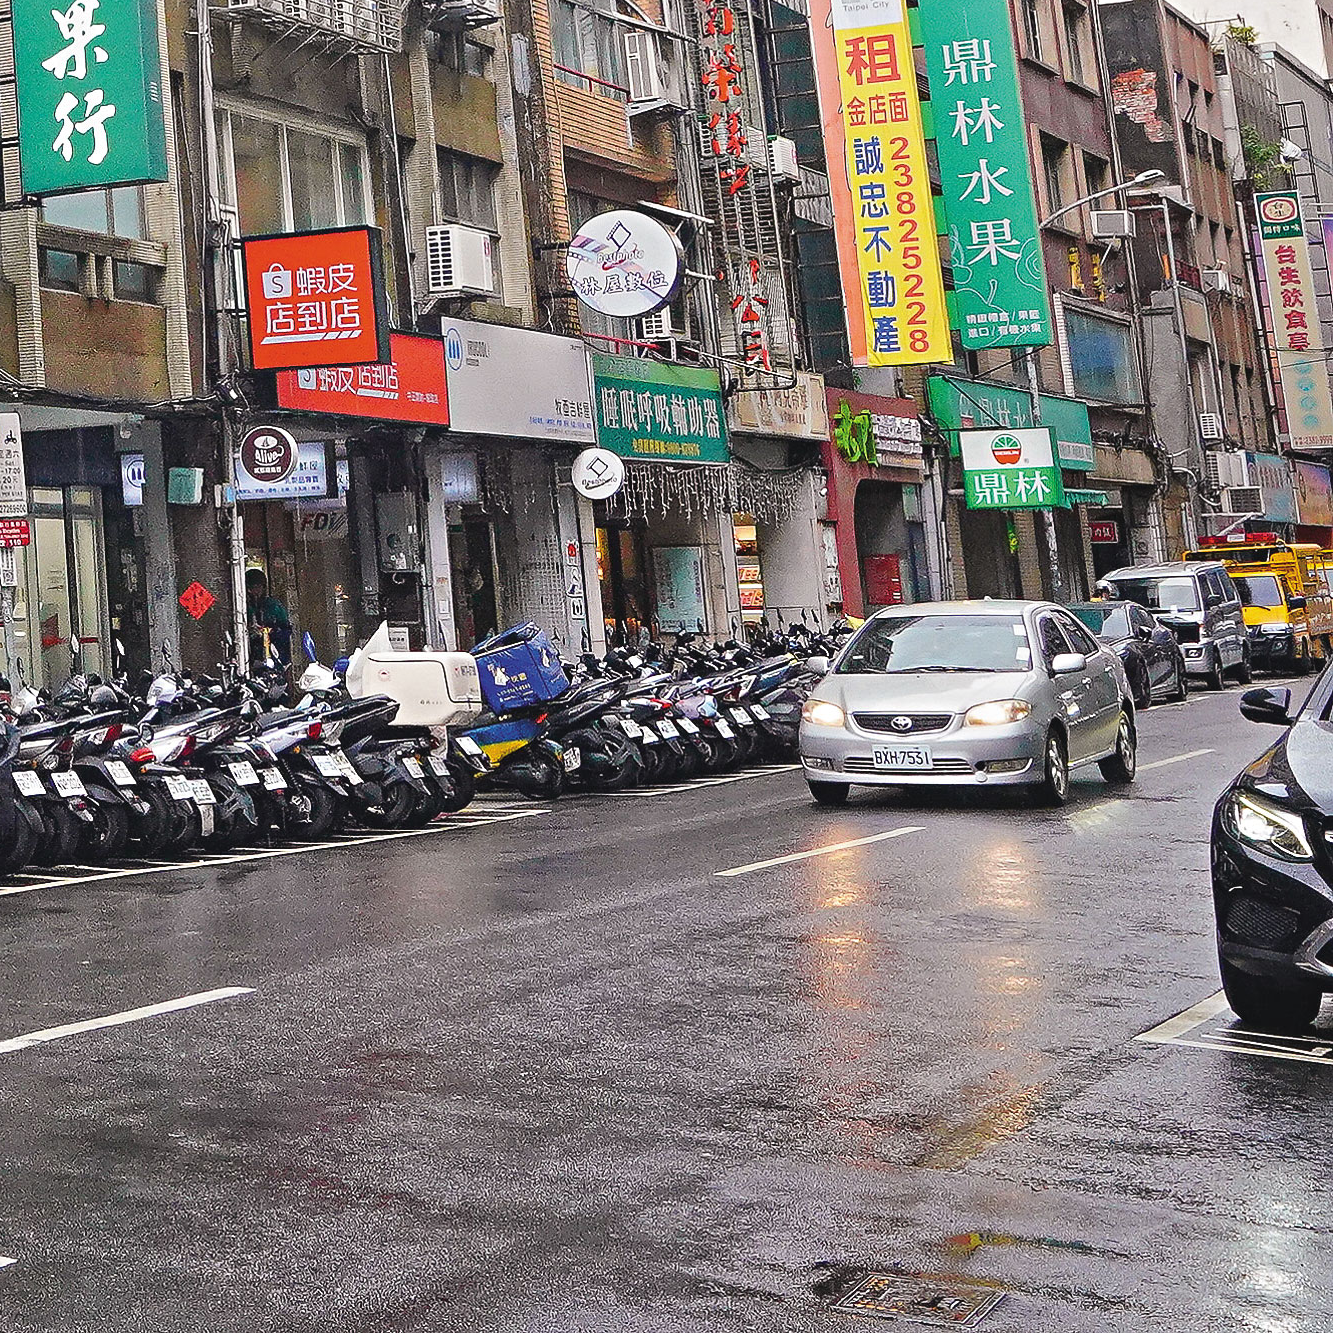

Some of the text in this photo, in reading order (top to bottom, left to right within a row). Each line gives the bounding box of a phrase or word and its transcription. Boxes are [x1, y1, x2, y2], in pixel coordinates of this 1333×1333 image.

[843, 1, 890, 13] Taipei City
[844, 34, 901, 86] 租
[847, 91, 909, 127] 金店面
[942, 37, 1021, 266] 鼎林水果
[854, 136, 901, 353] 誠忠不動產
[889, 137, 930, 353] 23825228
[296, 262, 357, 297] 蝦皮
[581, 270, 669, 297] 林屋數位
[266, 296, 360, 333] 店到店
[601, 387, 720, 439] 睡眠呼吸輔助器
[254, 449, 278, 464] Alive
[974, 471, 1051, 505] 鼎林
